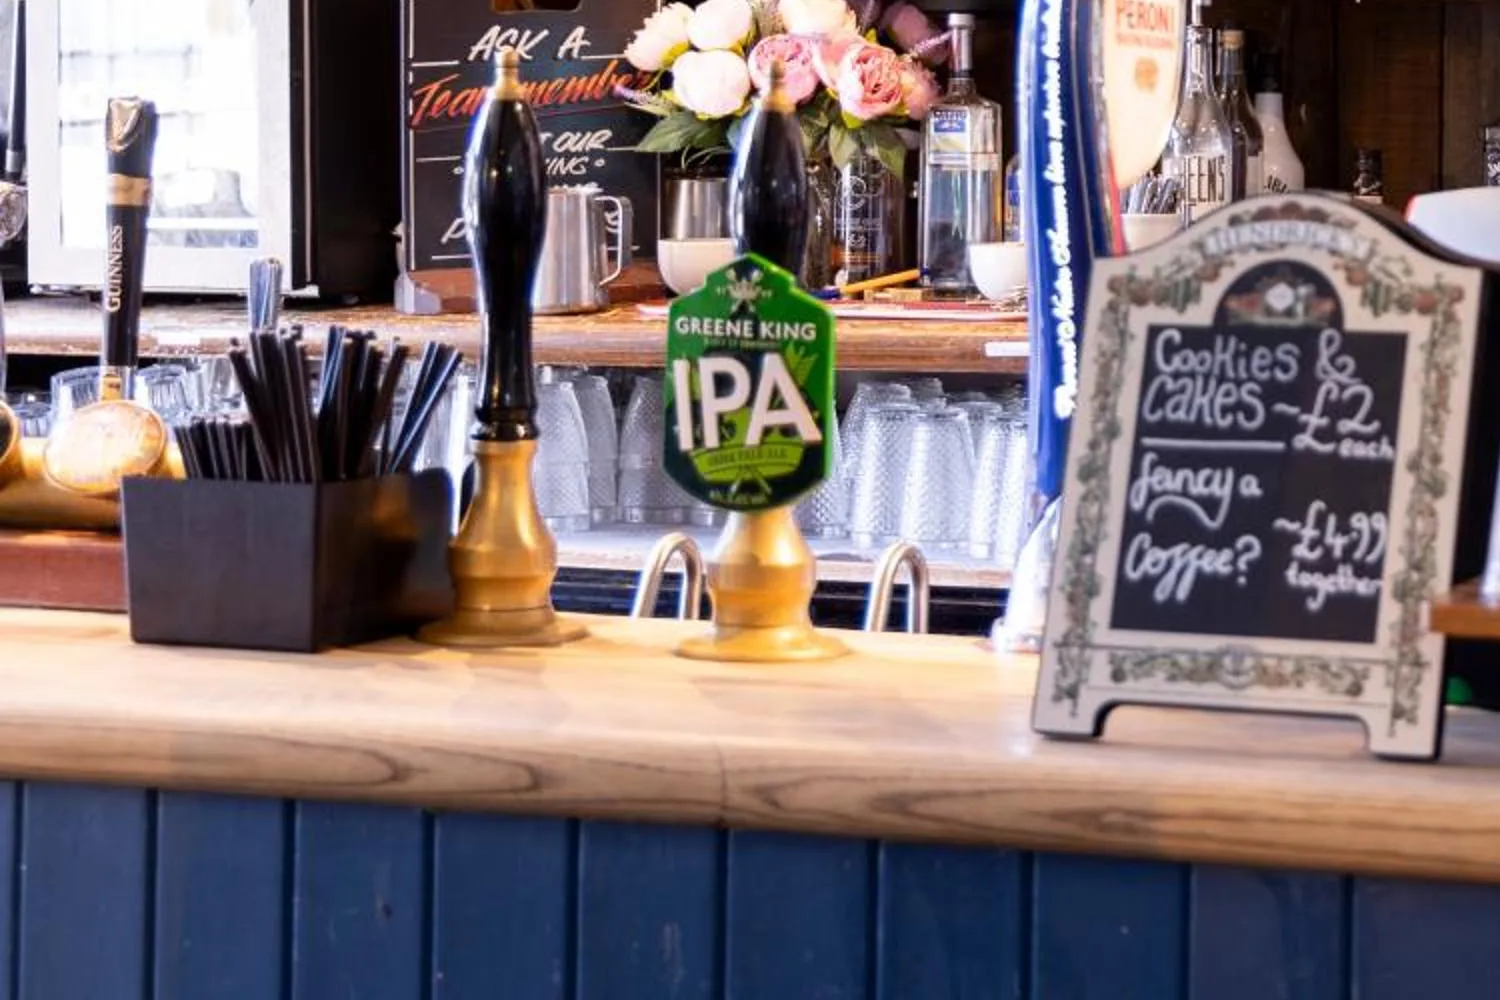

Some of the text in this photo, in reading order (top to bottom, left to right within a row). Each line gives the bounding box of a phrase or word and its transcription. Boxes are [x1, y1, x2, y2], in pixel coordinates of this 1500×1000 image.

[558, 26, 590, 59] A
[553, 130, 613, 153] OUR
[105, 225, 123, 313] GUINNESS
[675, 316, 817, 341] GREENE KING
[1153, 329, 1361, 384] Cookies &
[672, 352, 823, 452] IPA
[1143, 375, 1265, 429] Cakes
[1339, 436, 1394, 460] each
[1240, 474, 1263, 497] a
[1286, 561, 1383, 612] together
